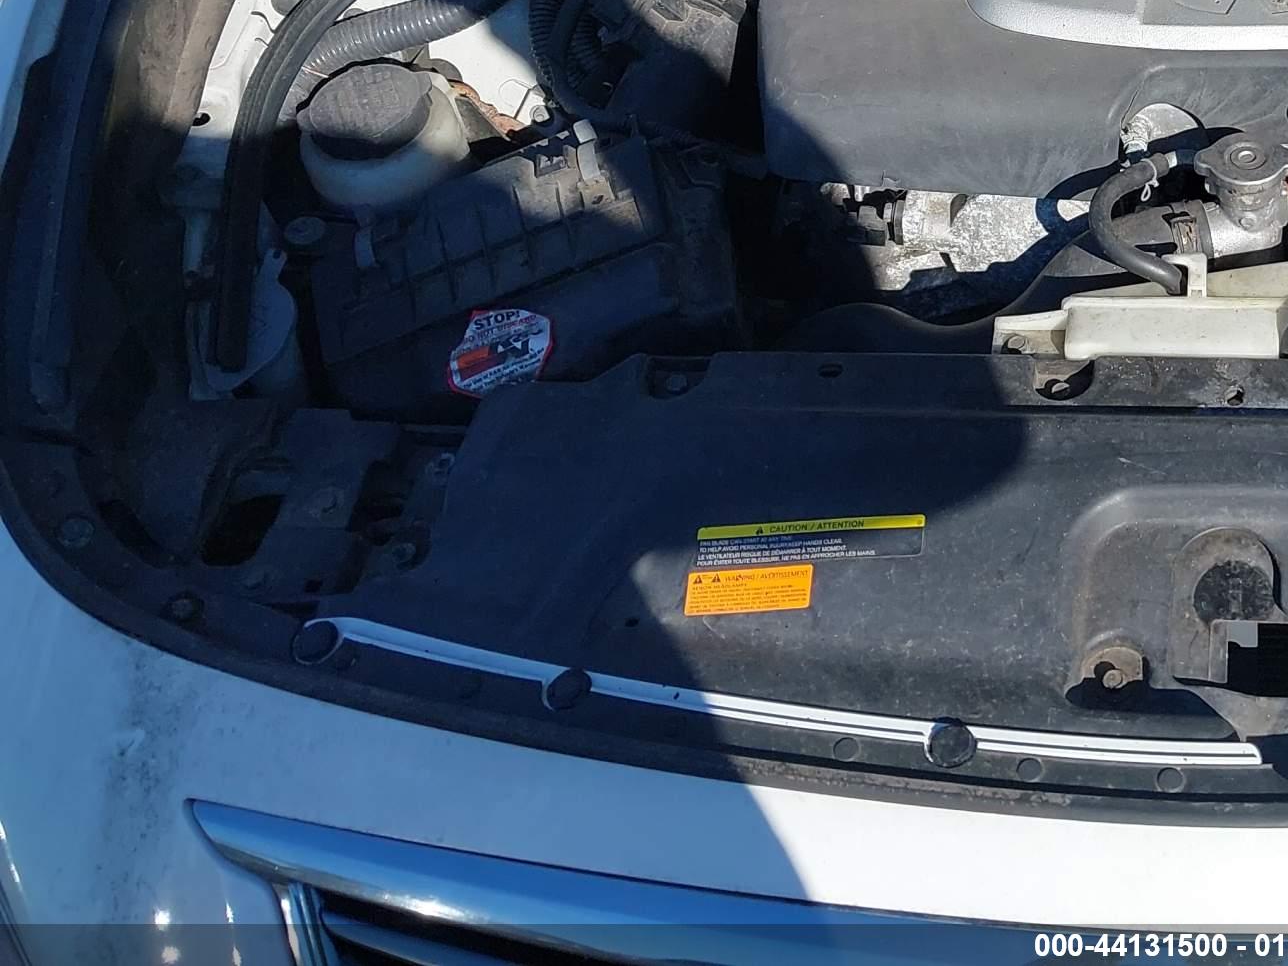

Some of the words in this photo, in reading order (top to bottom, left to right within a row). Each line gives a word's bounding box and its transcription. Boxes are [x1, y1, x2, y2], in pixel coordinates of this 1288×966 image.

[474, 310, 520, 330] STOP!
[769, 524, 808, 534] CAUTION
[816, 520, 865, 530] ATTENTION
[760, 570, 808, 580] AVERTISSEMENT
